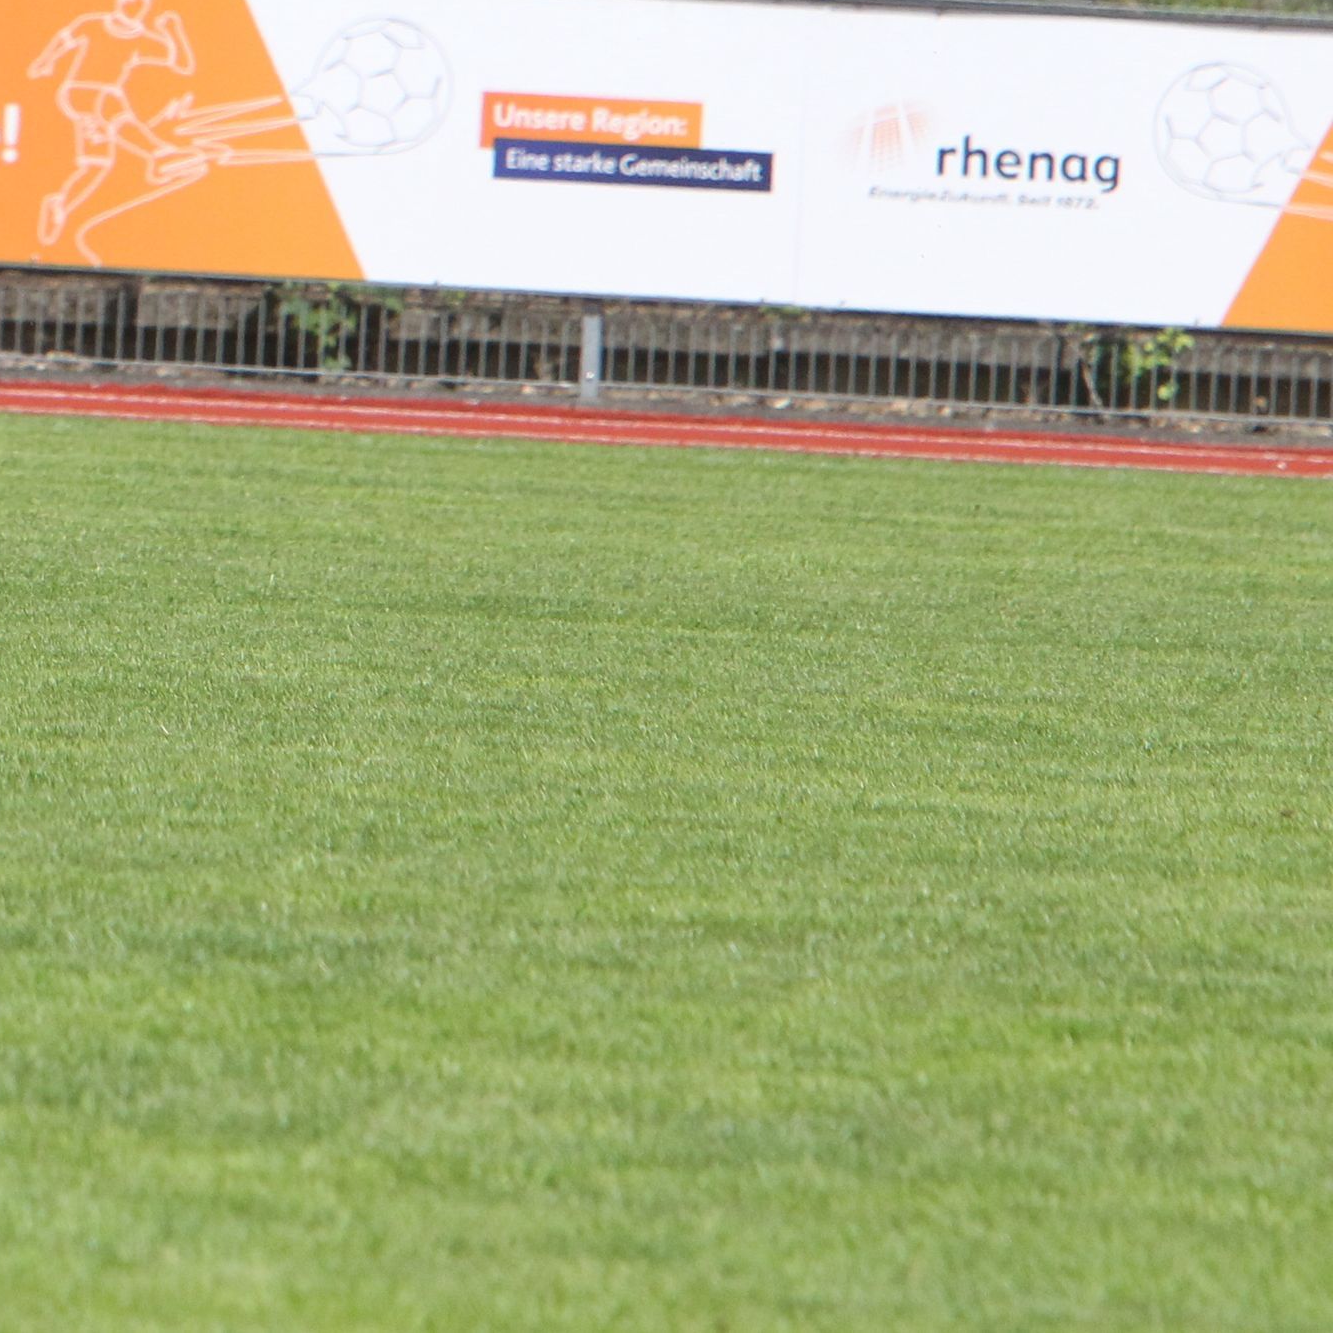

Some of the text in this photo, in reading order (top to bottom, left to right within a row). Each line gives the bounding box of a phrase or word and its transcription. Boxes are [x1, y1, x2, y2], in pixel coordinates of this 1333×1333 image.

[493, 102, 689, 141] Unsere Region:
[505, 147, 764, 183] Eine starke Gemeinschaft
[936, 135, 1121, 194] rhenag
